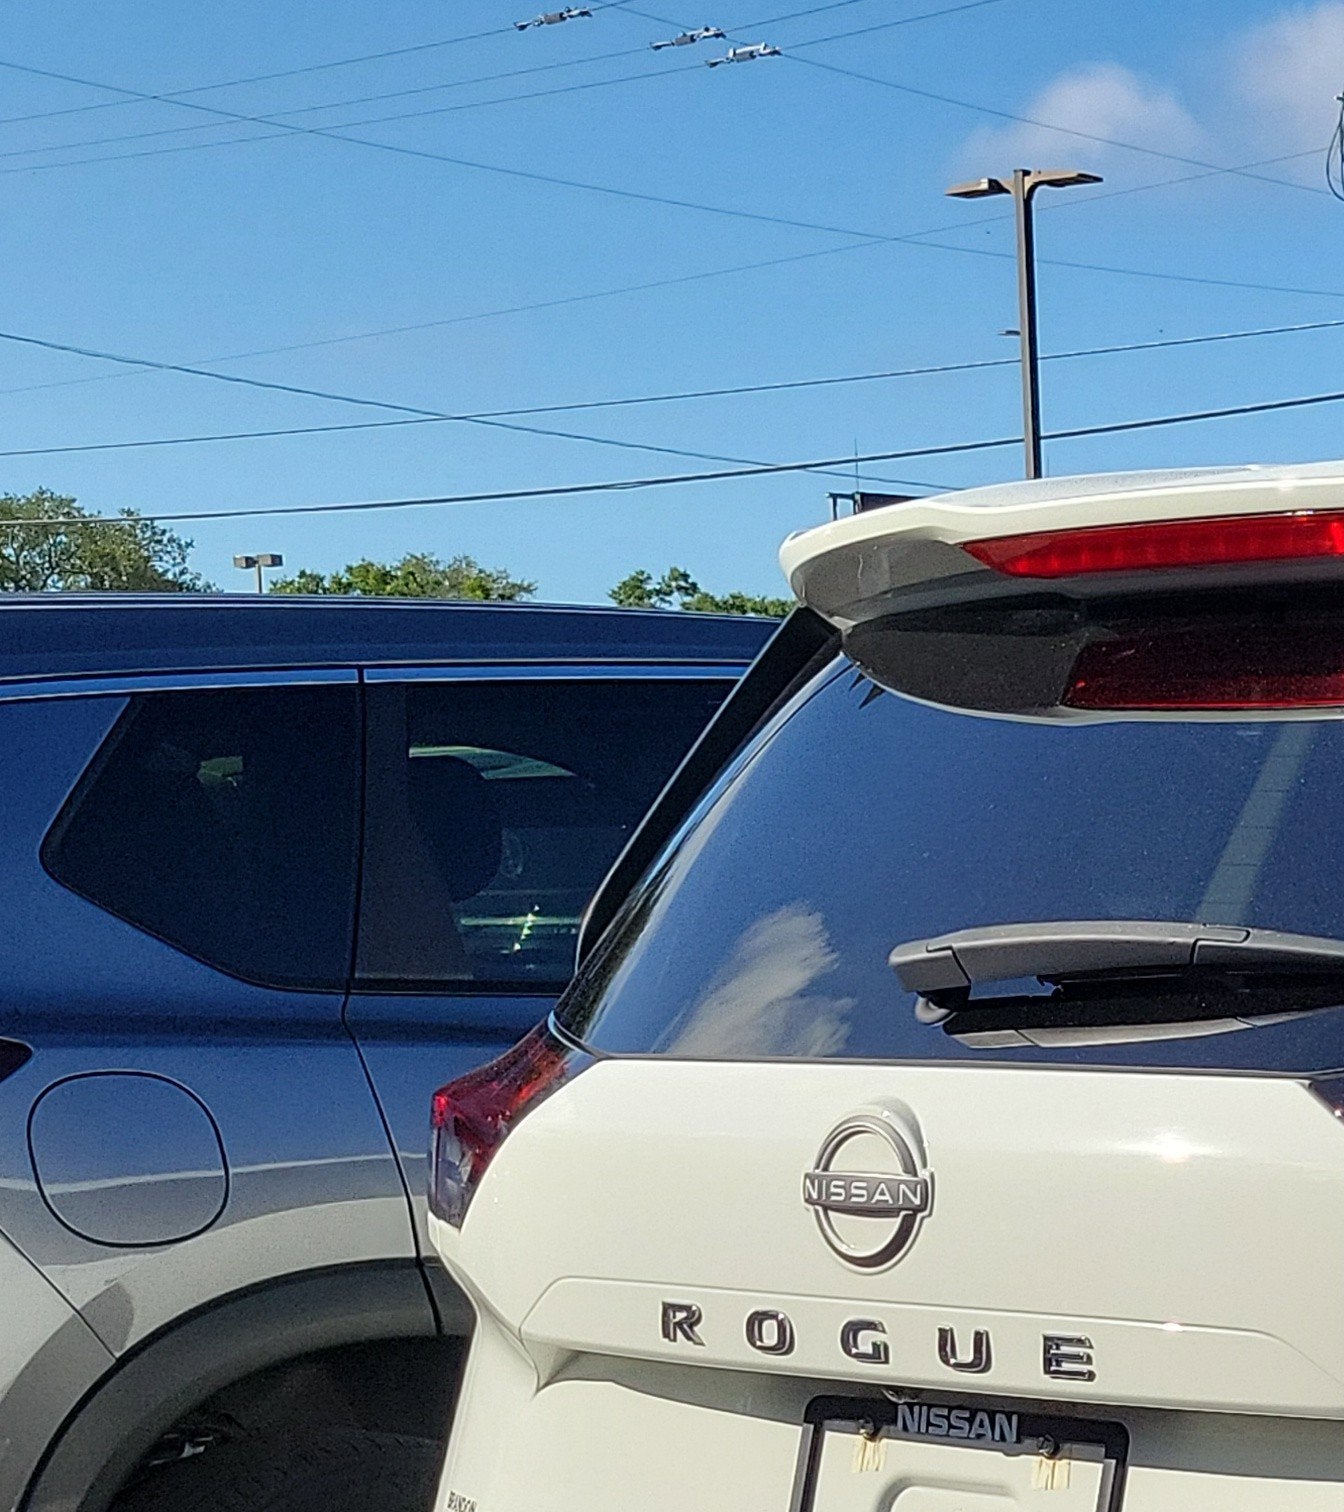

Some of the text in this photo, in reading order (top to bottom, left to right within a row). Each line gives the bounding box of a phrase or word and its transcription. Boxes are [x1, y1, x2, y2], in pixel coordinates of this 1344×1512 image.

[805, 1177, 922, 1207] NISSAN
[660, 1300, 1097, 1381] ROGUE
[896, 1403, 1019, 1444] NISSAN
